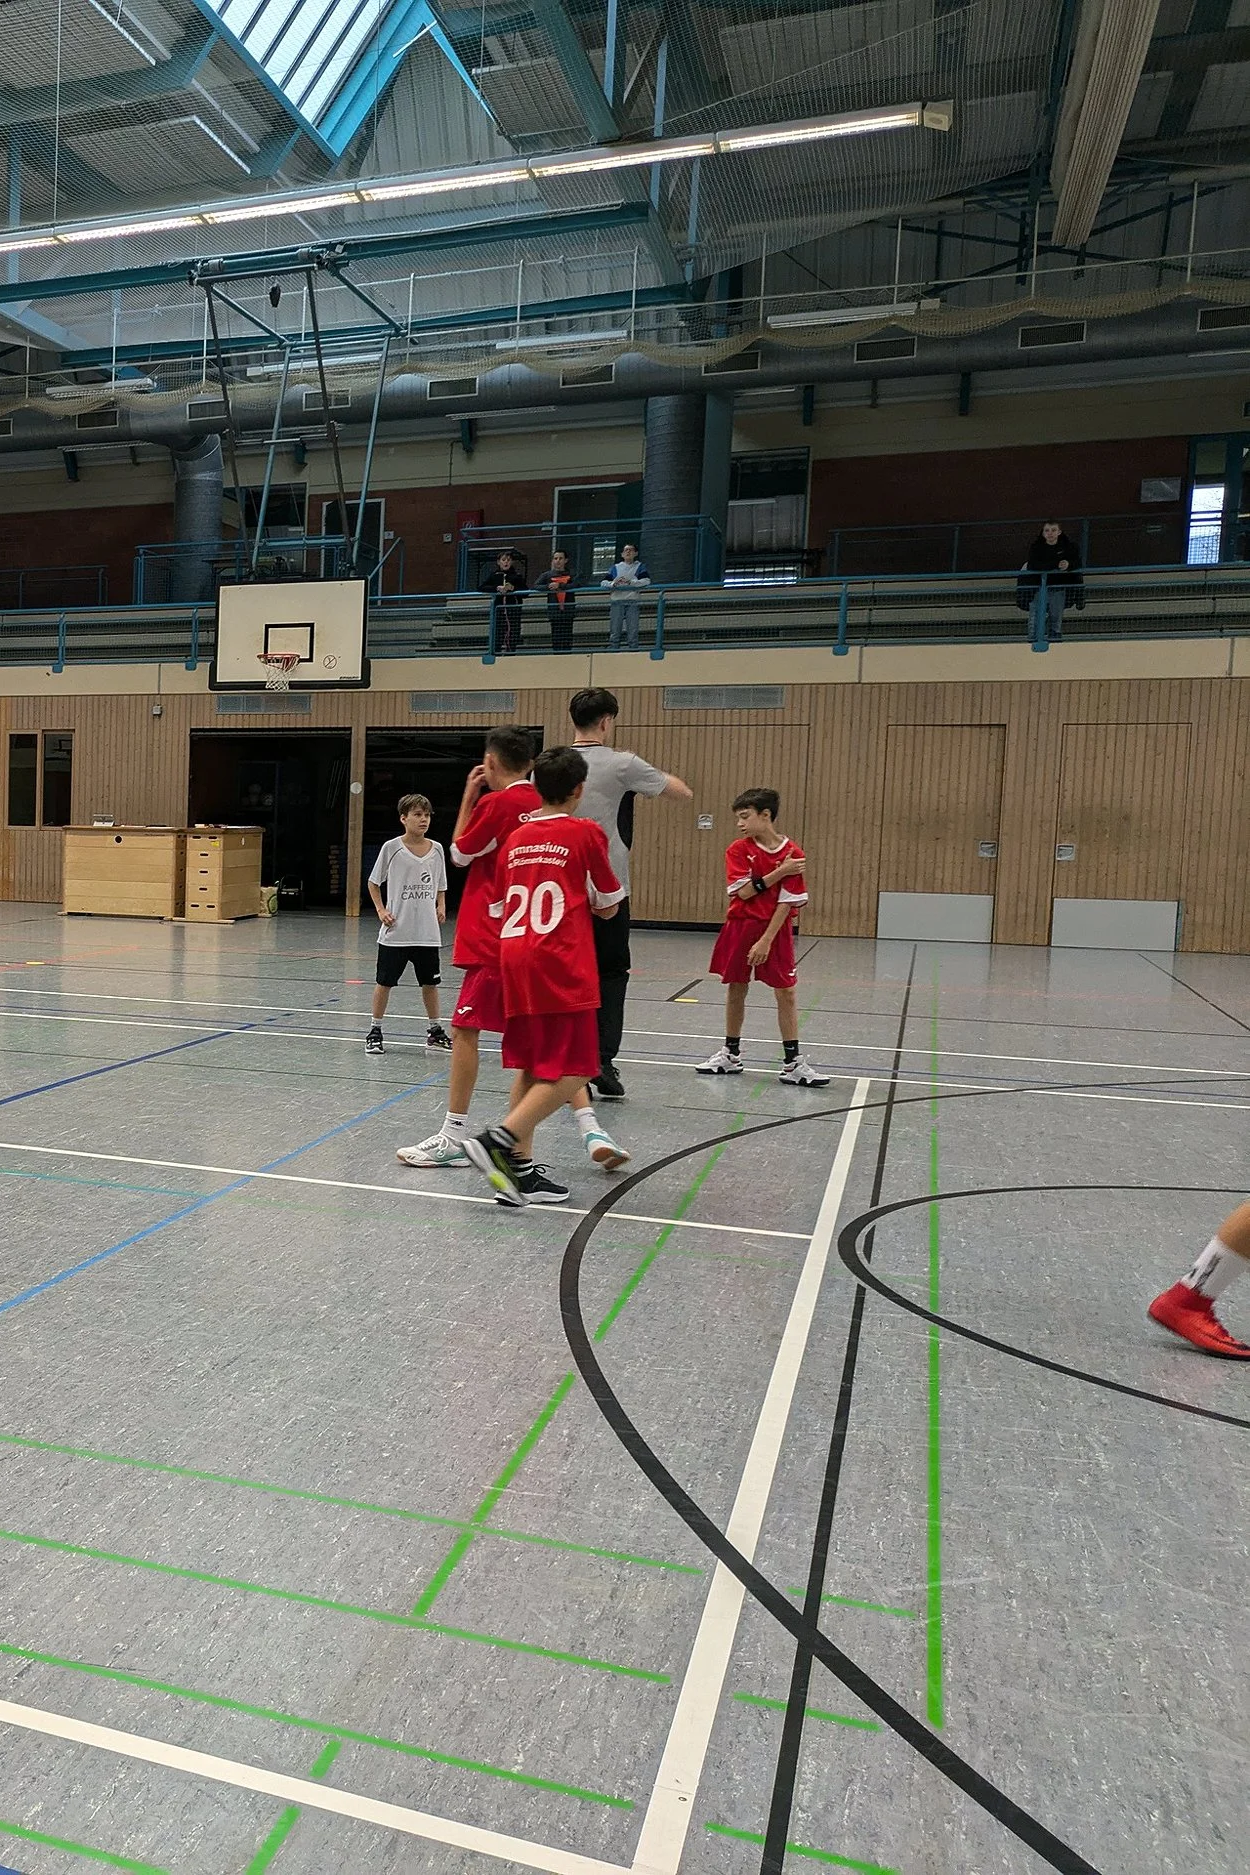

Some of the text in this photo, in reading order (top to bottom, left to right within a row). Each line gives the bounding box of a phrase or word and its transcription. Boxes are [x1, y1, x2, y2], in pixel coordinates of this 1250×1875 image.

[507, 841, 570, 860] ymnasium
[400, 891, 435, 901] CAMPU
[499, 880, 565, 939] 20
